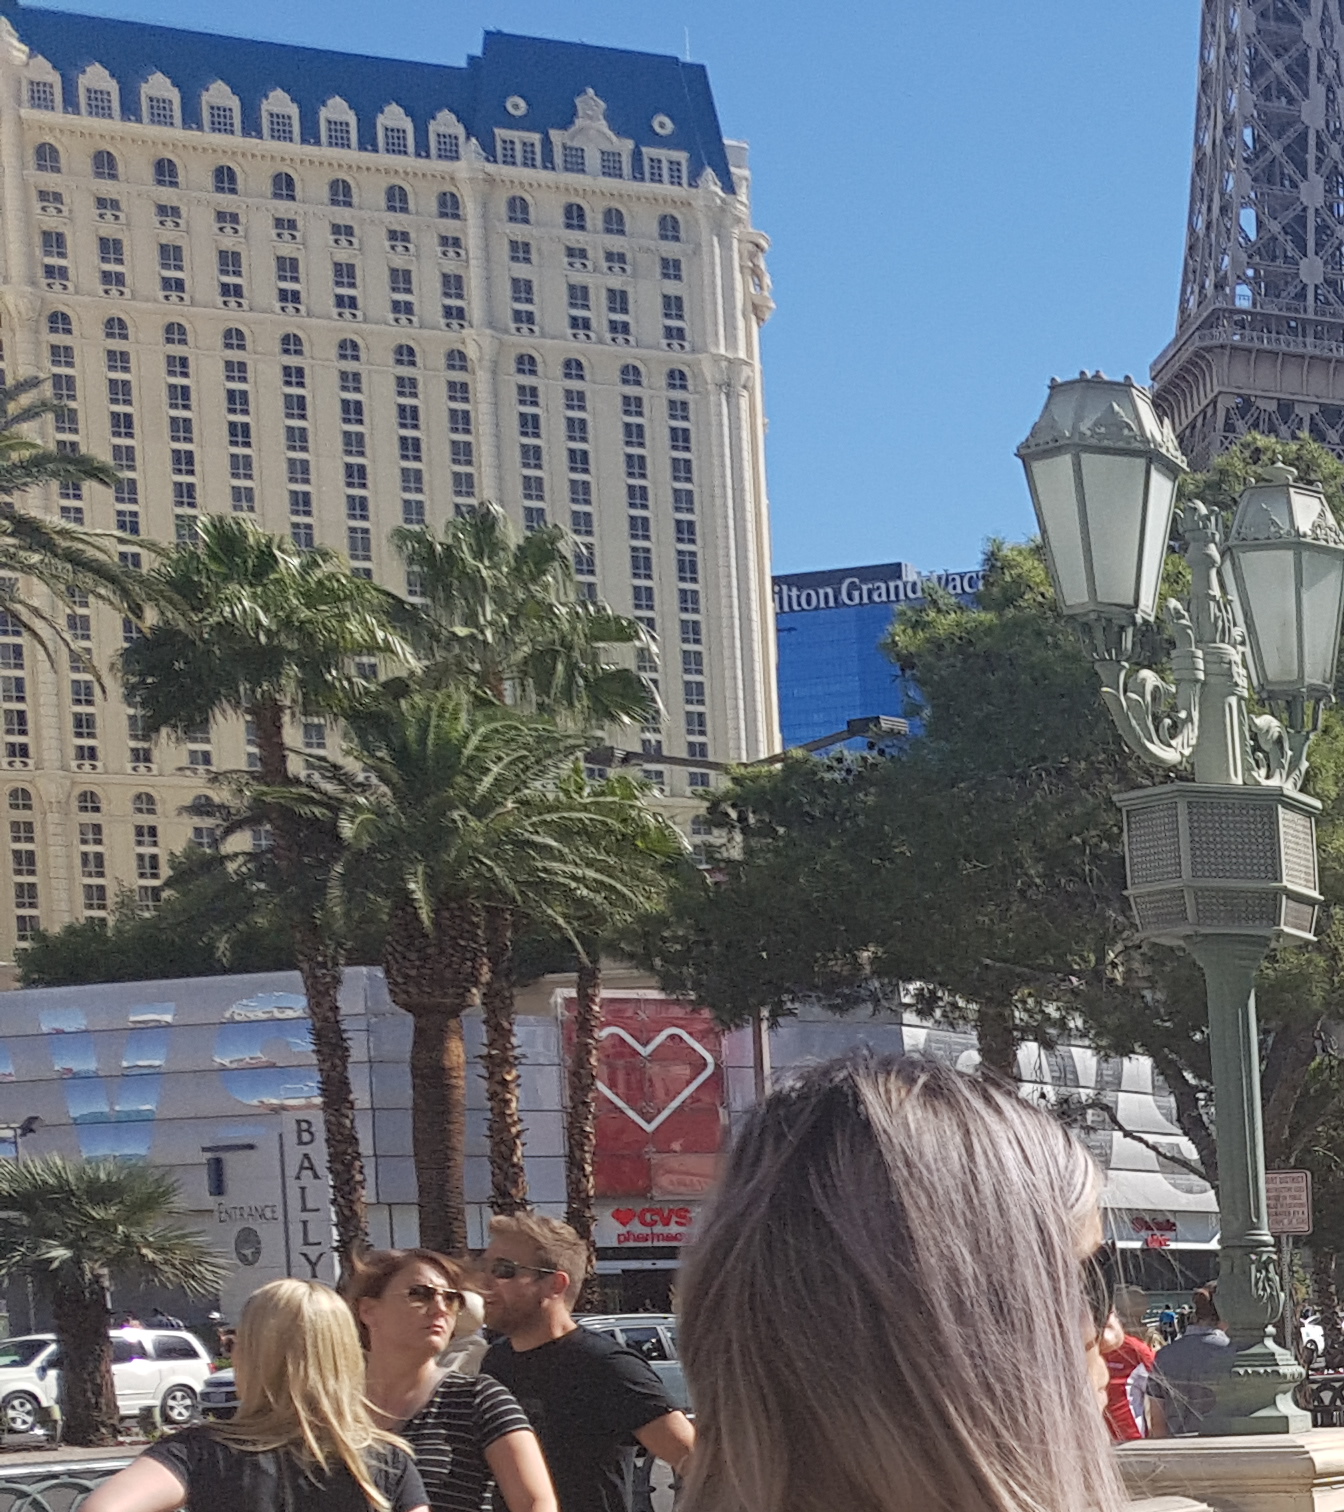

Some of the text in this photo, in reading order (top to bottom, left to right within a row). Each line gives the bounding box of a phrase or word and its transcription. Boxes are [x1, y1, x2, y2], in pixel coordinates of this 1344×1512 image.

[773, 583, 836, 614] ilton
[840, 577, 922, 607] Grand
[638, 1207, 692, 1227] CVS
[616, 1230, 693, 1245] pharmac
